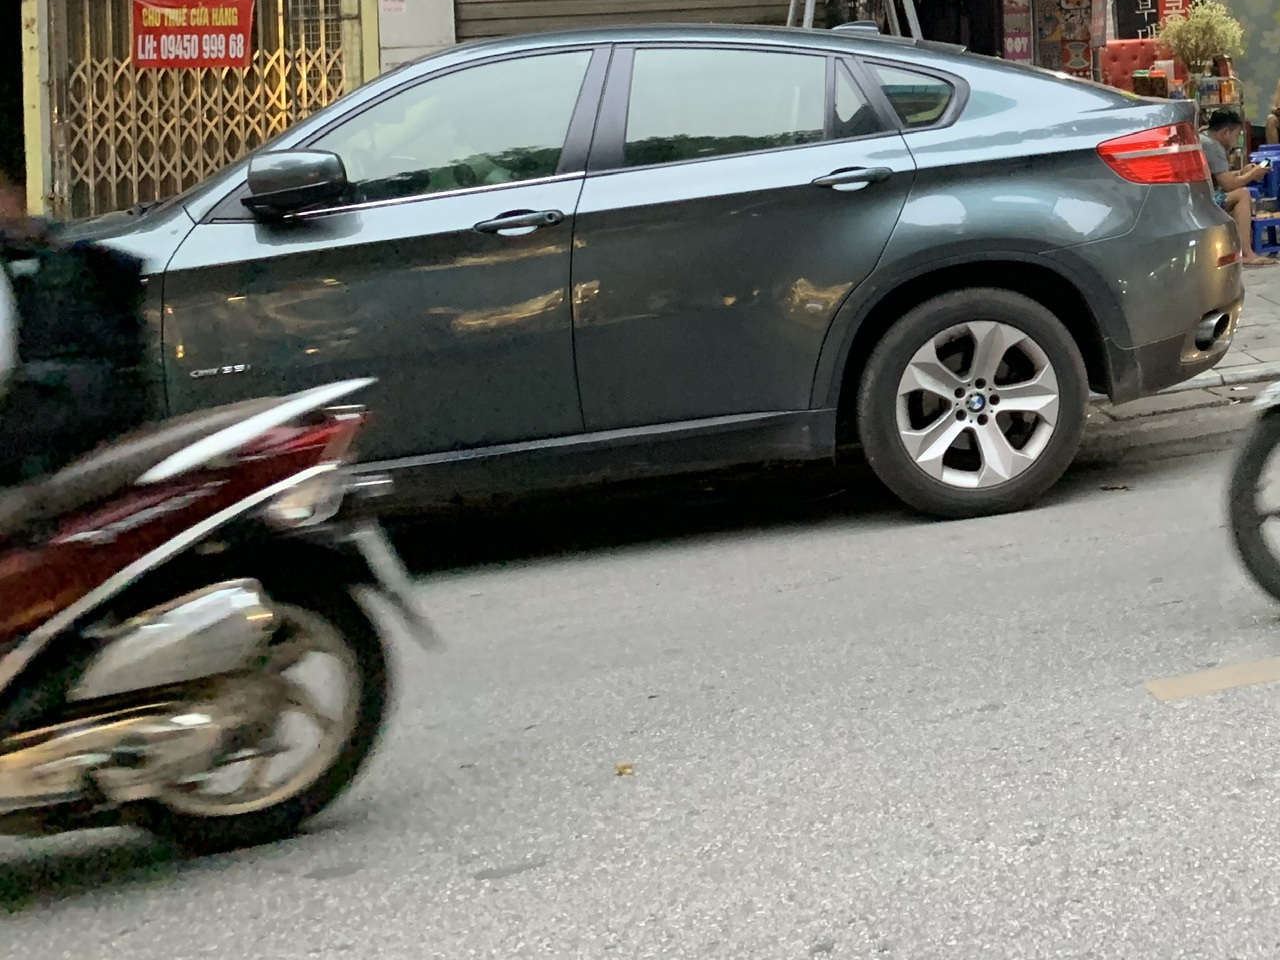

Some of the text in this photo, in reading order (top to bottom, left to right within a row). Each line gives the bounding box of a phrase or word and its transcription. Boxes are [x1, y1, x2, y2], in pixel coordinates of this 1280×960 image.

[137, 33, 244, 60] LH: 09450 999 68
